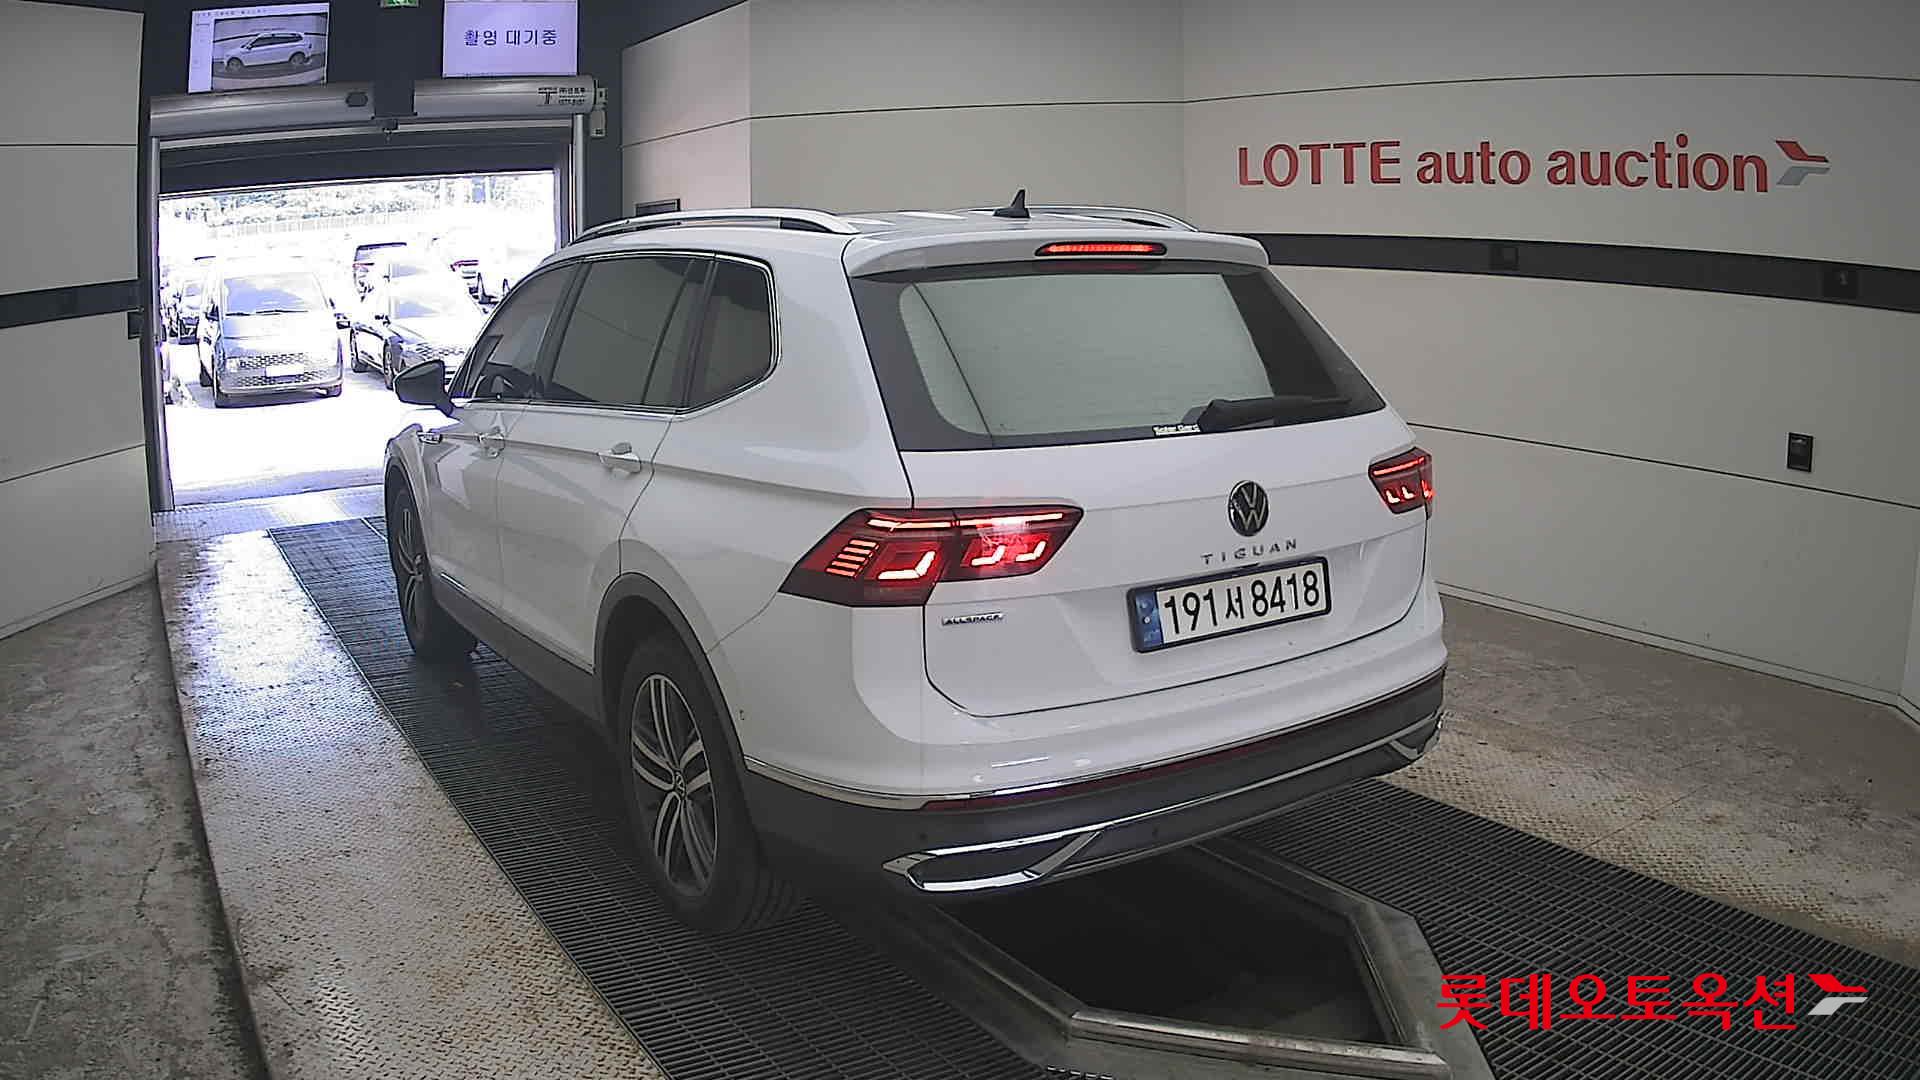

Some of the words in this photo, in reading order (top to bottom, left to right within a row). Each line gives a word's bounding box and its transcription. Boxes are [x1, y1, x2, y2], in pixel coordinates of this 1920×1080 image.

[505, 29, 557, 46] 대기중
[1238, 140, 1400, 187] LOTTE
[1416, 141, 1531, 185] auto
[1546, 133, 1769, 193] auction
[1200, 538, 1297, 565] TIGUAN
